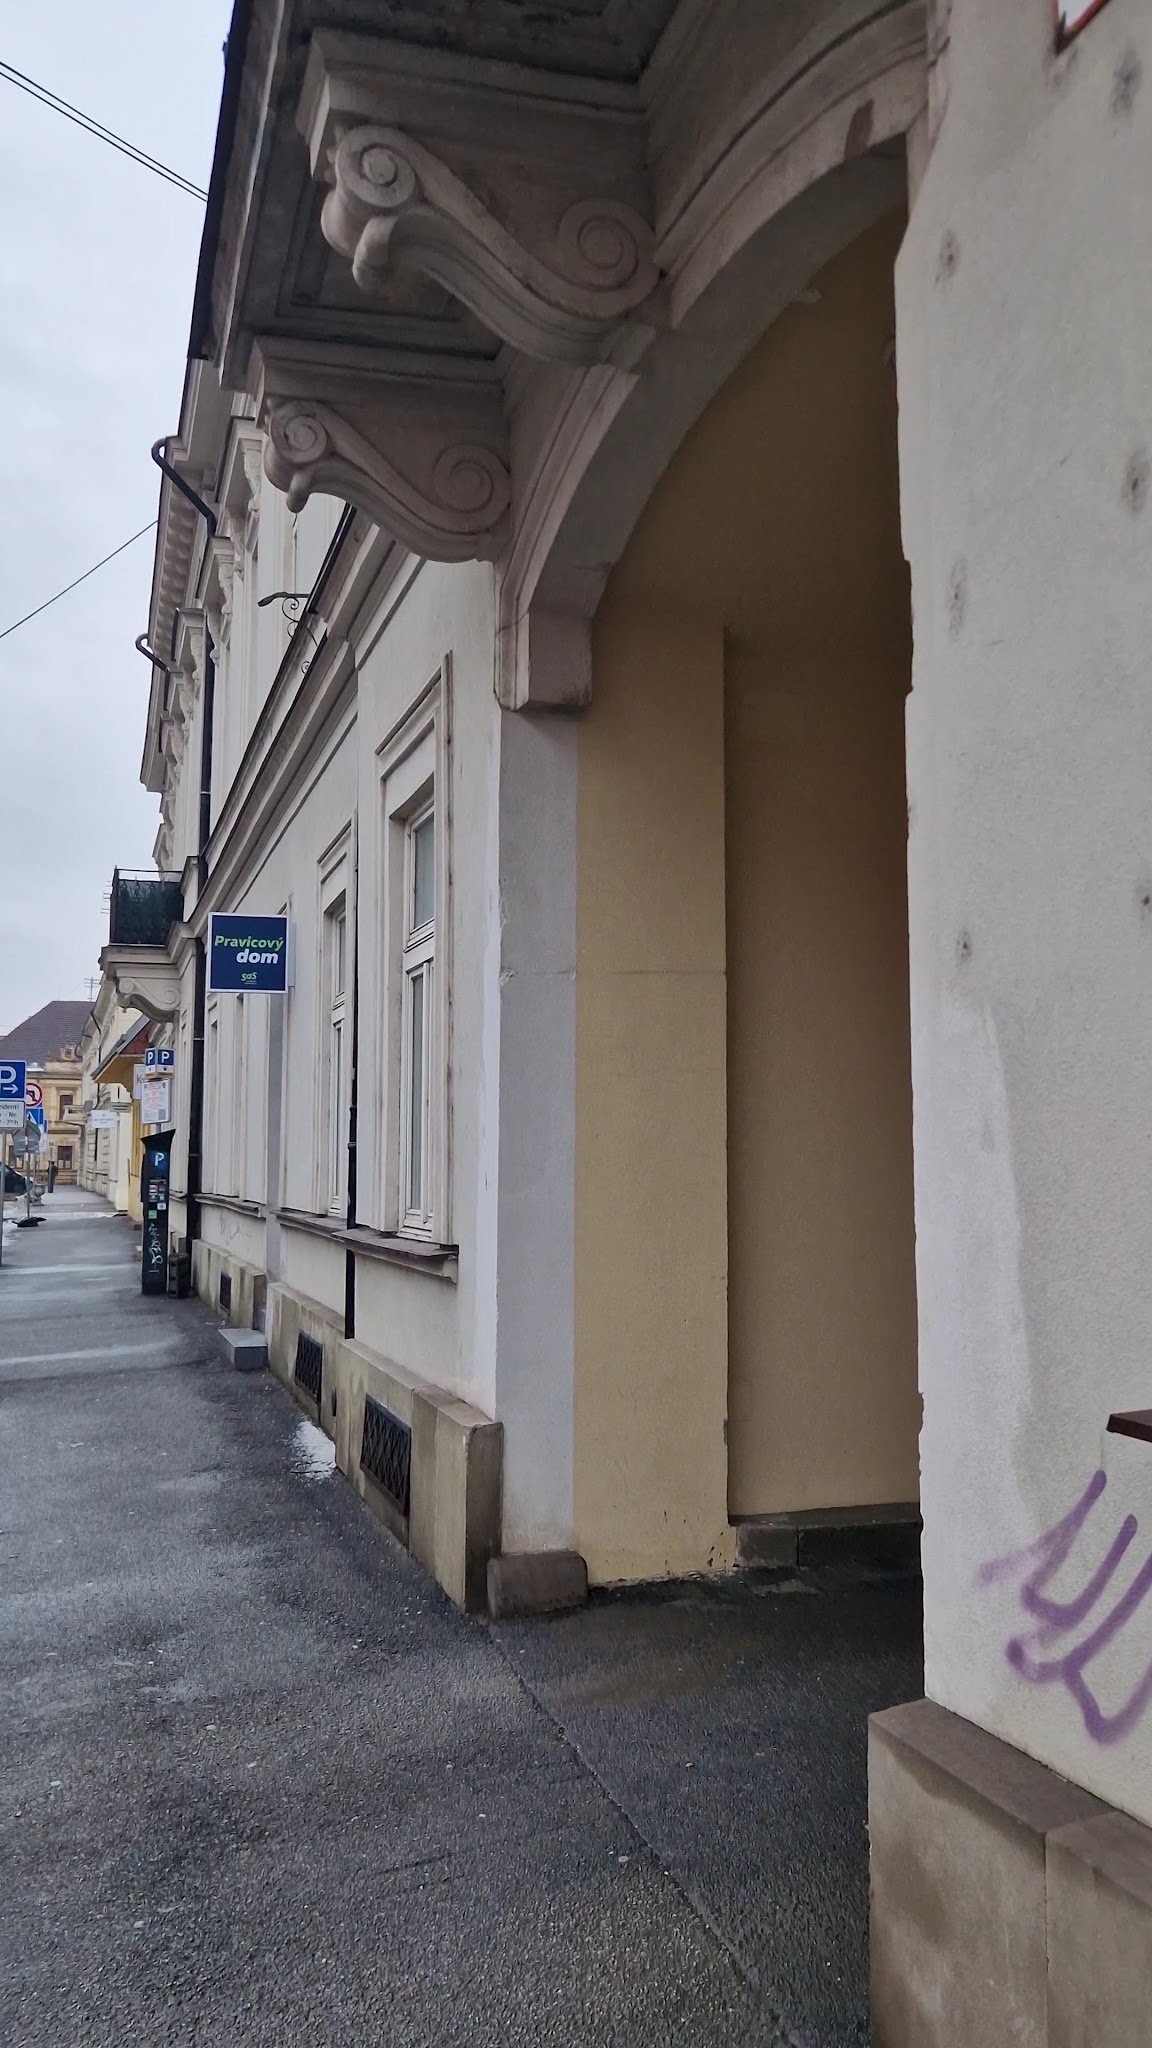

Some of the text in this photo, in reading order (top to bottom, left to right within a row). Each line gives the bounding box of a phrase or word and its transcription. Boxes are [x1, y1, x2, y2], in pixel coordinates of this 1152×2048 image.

[215, 936, 283, 951] Pravicový
[237, 949, 278, 963] dom
[148, 1052, 154, 1064] P
[161, 1051, 170, 1063] P
[154, 1153, 164, 1166] P
